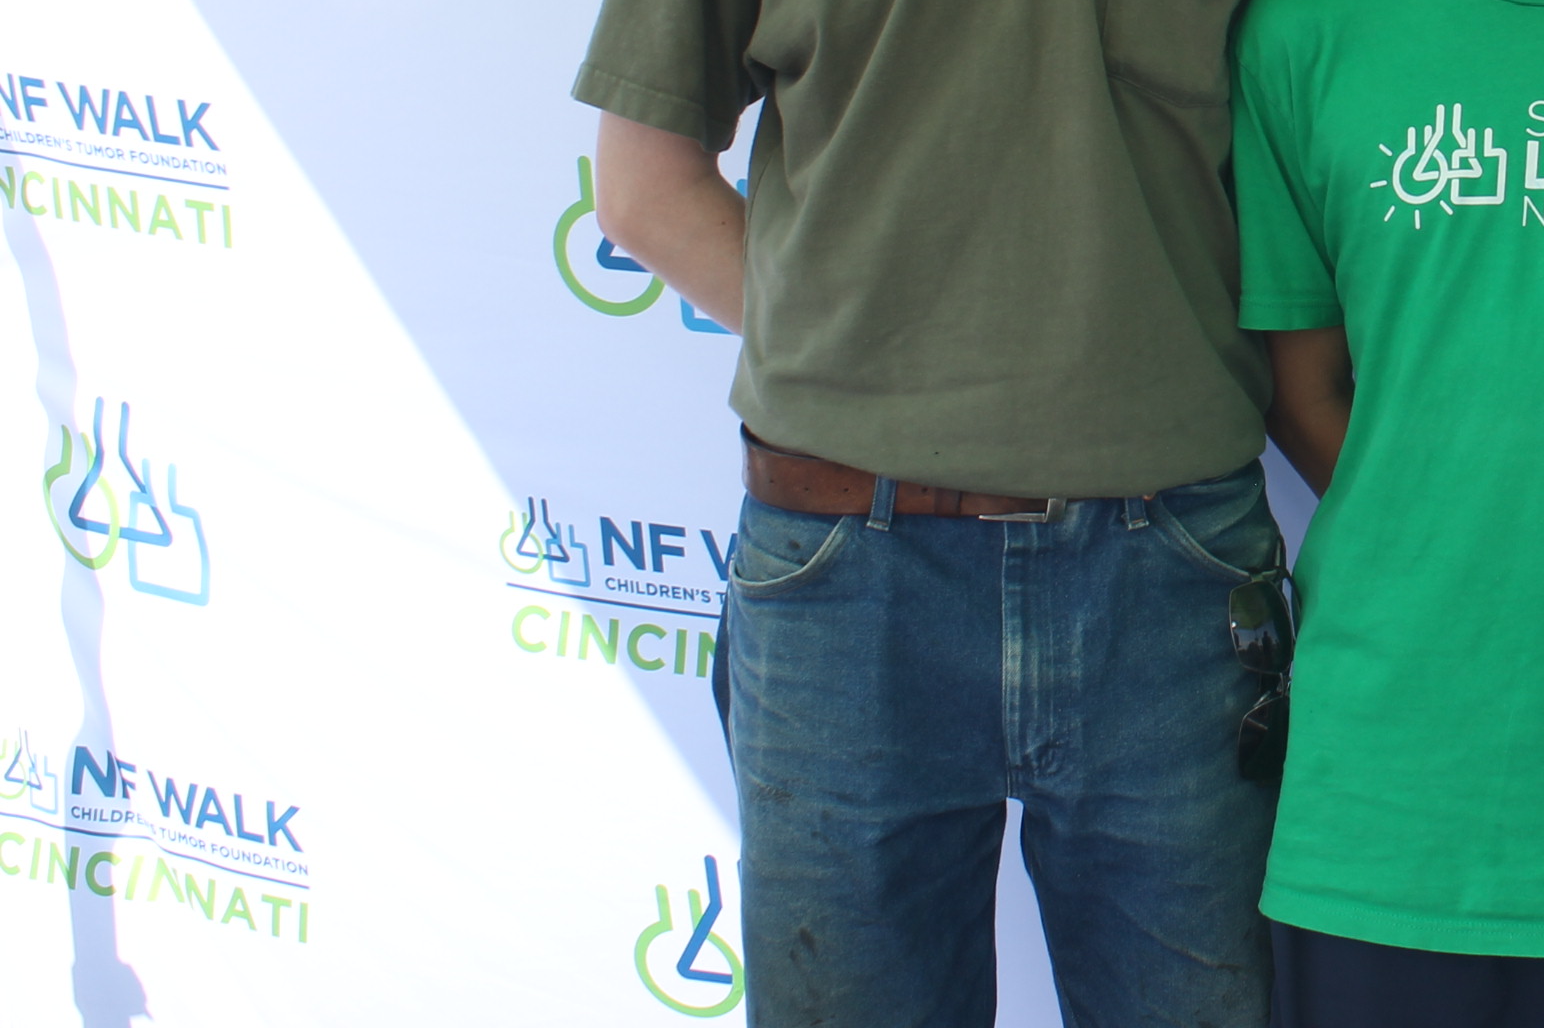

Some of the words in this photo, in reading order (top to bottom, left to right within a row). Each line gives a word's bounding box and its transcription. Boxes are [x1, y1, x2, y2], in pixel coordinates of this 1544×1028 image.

[56, 81, 221, 152] WALK
[76, 141, 125, 161] TUMOR
[130, 150, 228, 176] FOUNDATION
[600, 516, 686, 573] NF
[605, 577, 711, 604] CHILDREN'S
[71, 745, 137, 800] NF
[147, 769, 304, 853] WALK
[159, 826, 206, 852] TUMOR
[211, 842, 309, 876] FOUNDATION
